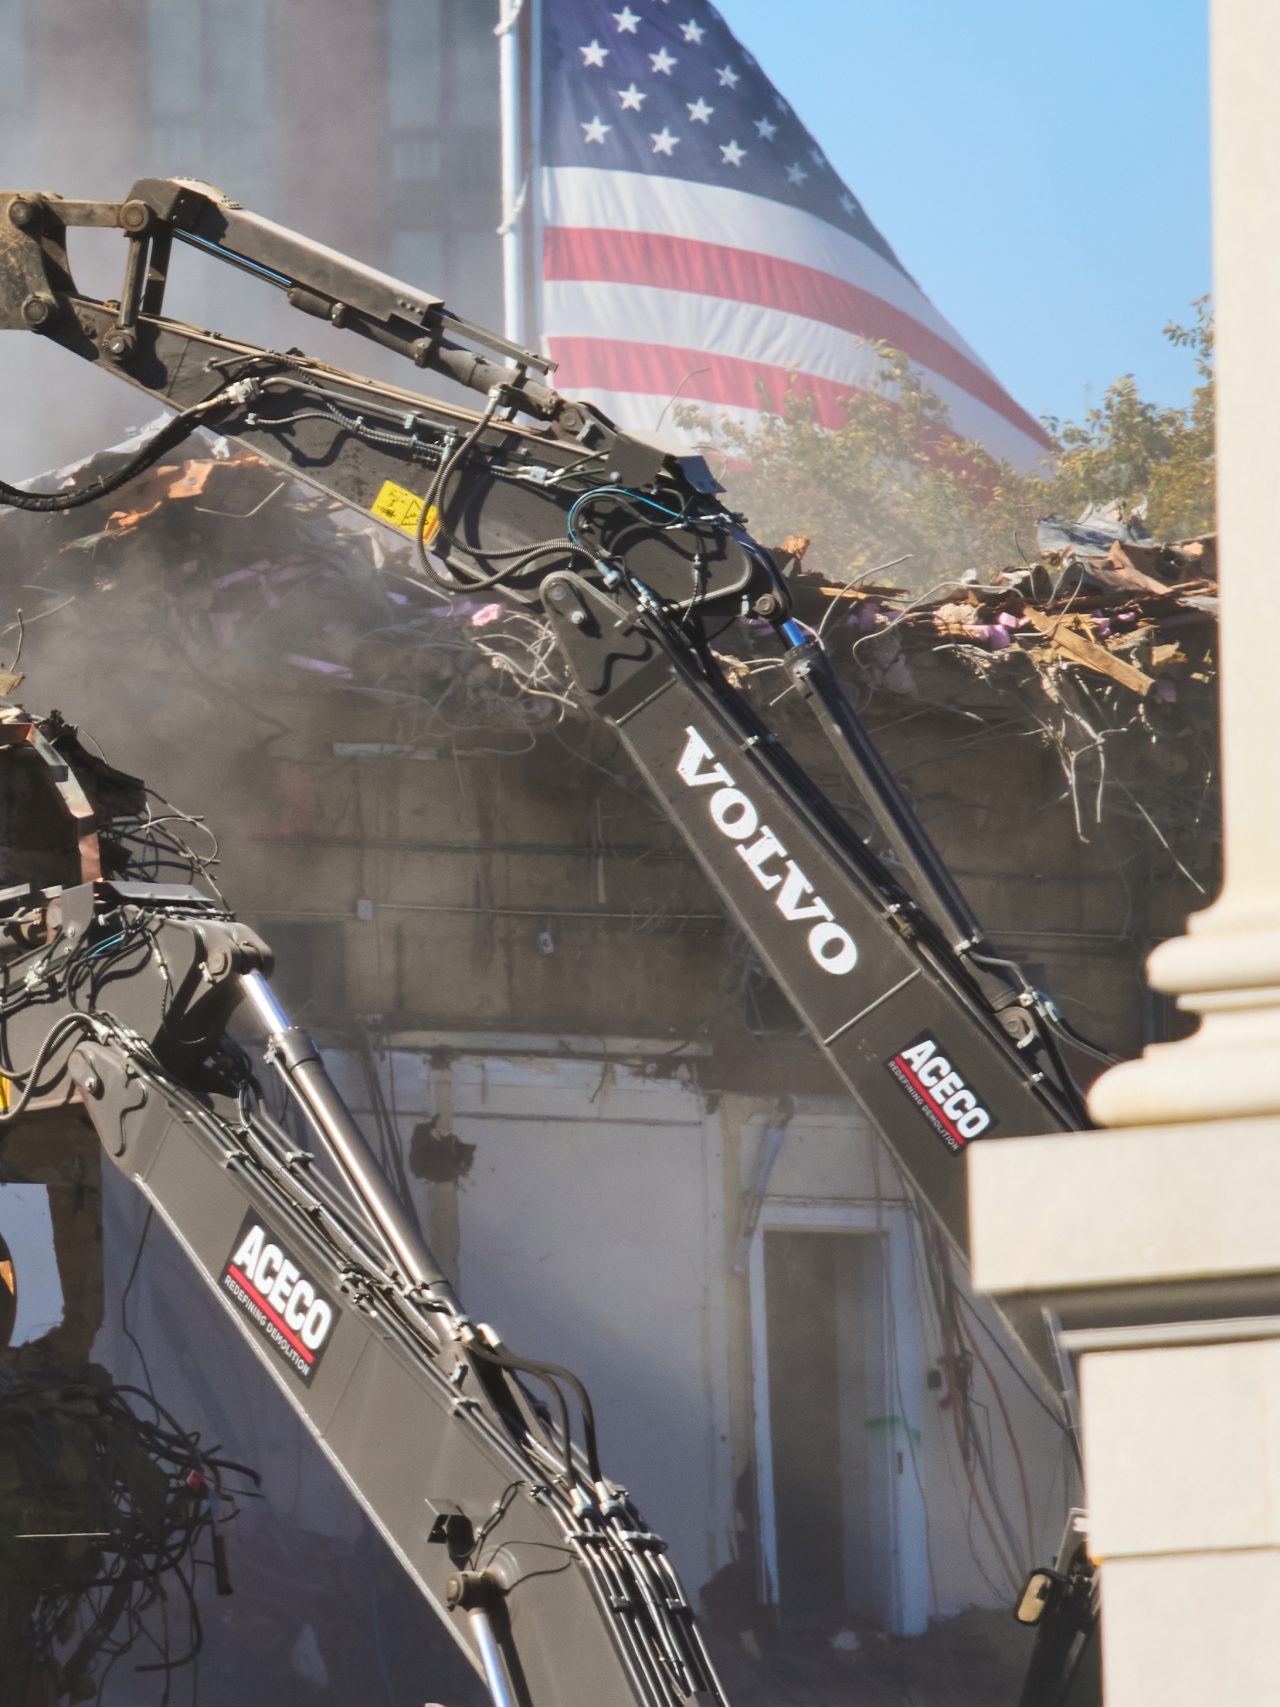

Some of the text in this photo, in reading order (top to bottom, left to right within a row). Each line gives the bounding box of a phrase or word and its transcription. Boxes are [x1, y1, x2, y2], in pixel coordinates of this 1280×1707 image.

[676, 725, 857, 975] VOLVO
[888, 1061, 959, 1151] REDEFINING DEMOLITION
[901, 1040, 990, 1138] ACECO
[224, 1274, 310, 1376] REDEFINING DEMOLITION
[232, 1224, 332, 1350] ACECO
